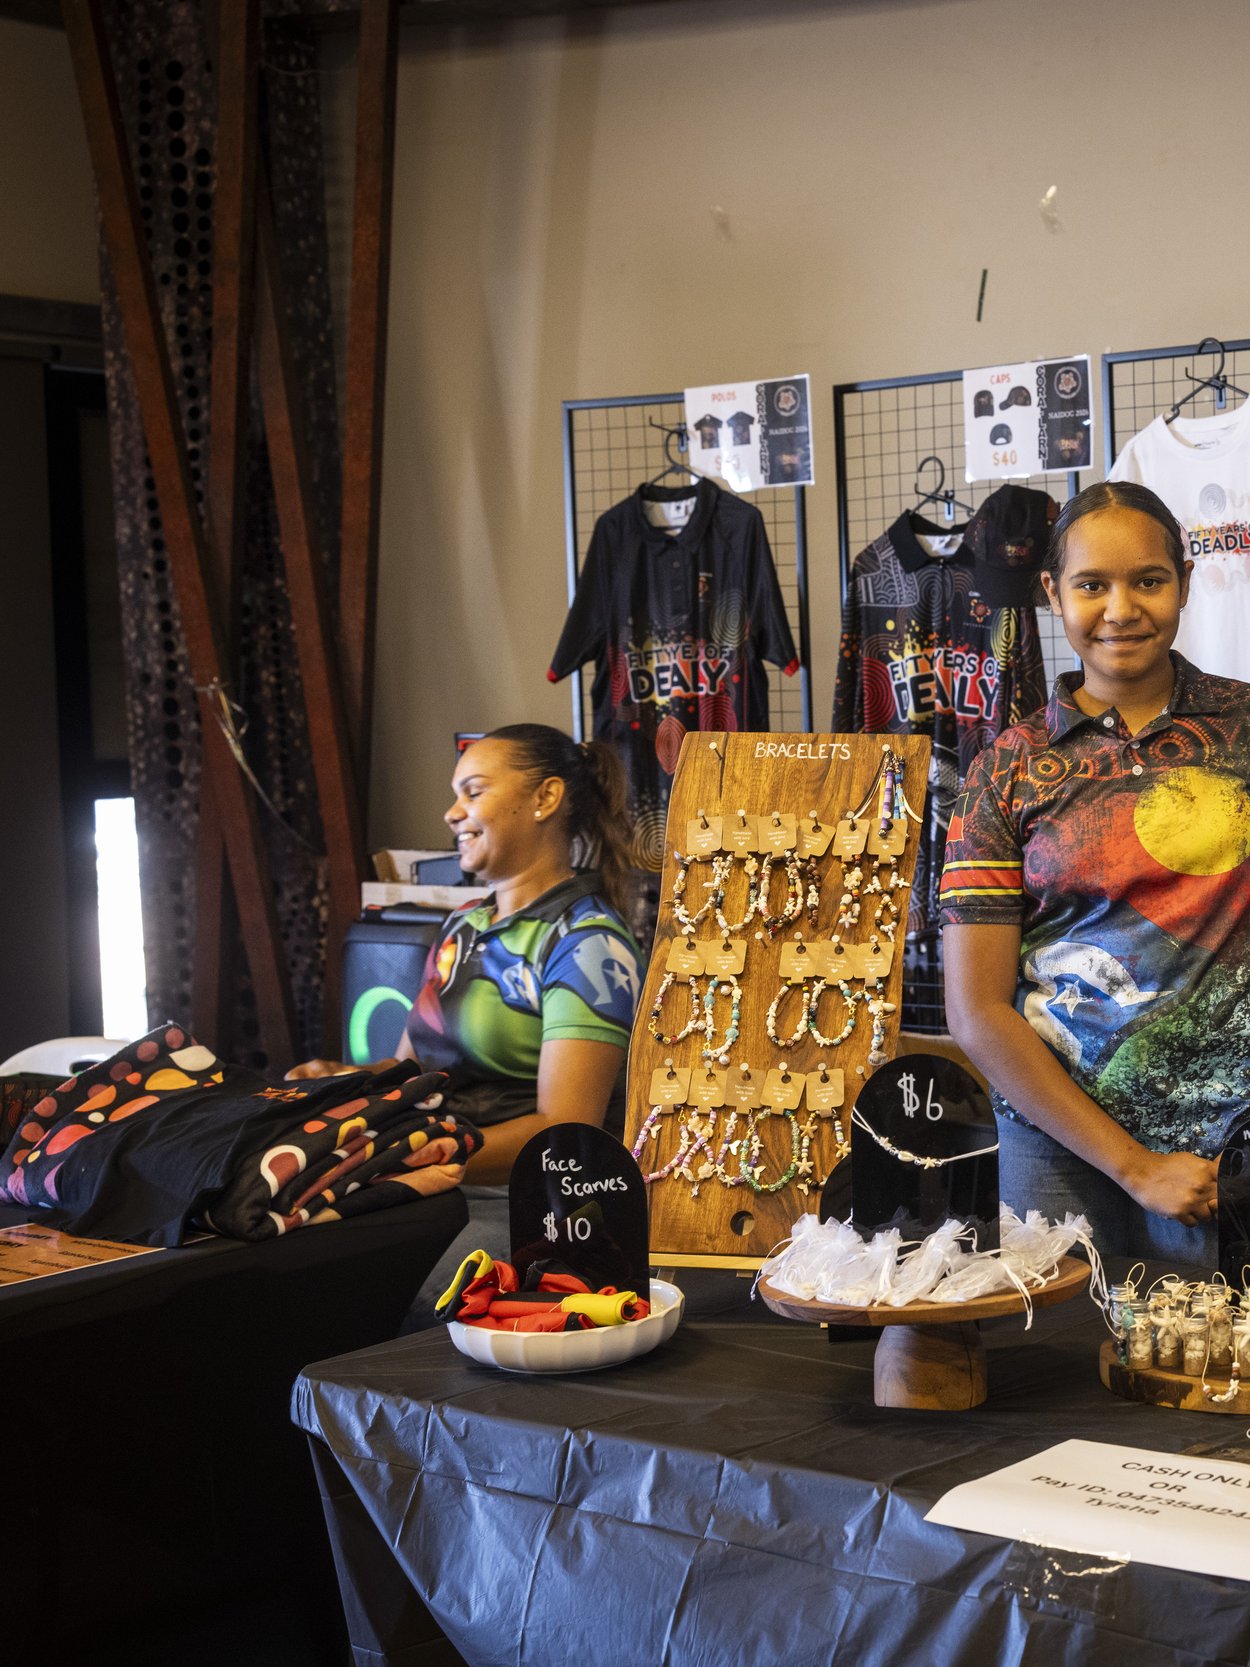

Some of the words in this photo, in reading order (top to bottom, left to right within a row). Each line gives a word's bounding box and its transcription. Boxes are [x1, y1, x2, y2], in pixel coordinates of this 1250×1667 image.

[990, 374, 1011, 385] CAPS
[993, 450, 1017, 466] $40
[1188, 528, 1212, 540] FIFTY
[1215, 523, 1246, 535] YEARS
[704, 644, 730, 660] OF
[755, 742, 851, 760] BRACELETS
[897, 1072, 943, 1121] $6
[541, 1148, 582, 1172] Face
[561, 1176, 628, 1197] Scarves
[1121, 1461, 1193, 1478] CASH
[1032, 1475, 1076, 1489] Pay
[1077, 1484, 1114, 1495] ID:
[1148, 1481, 1187, 1493] OR
[1085, 1498, 1161, 1516] Tyisha
